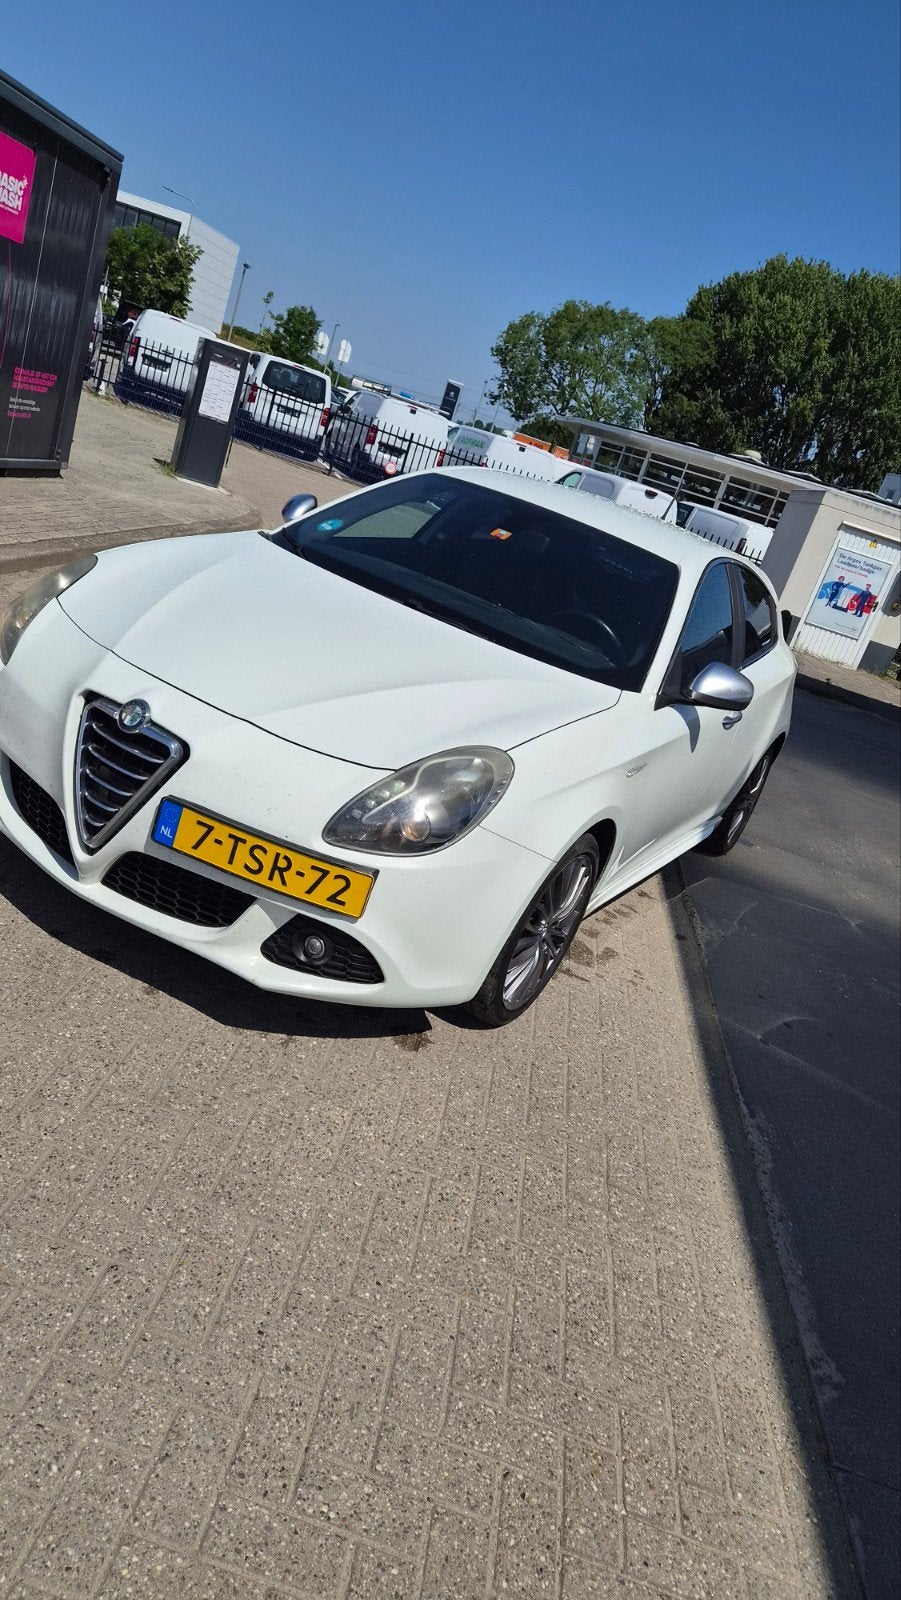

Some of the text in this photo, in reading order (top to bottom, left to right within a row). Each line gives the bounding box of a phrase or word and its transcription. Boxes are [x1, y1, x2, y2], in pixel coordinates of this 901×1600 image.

[0, 170, 25, 197] ASIC
[160, 825, 173, 838] NL
[191, 819, 352, 907] 7-TSR-72
